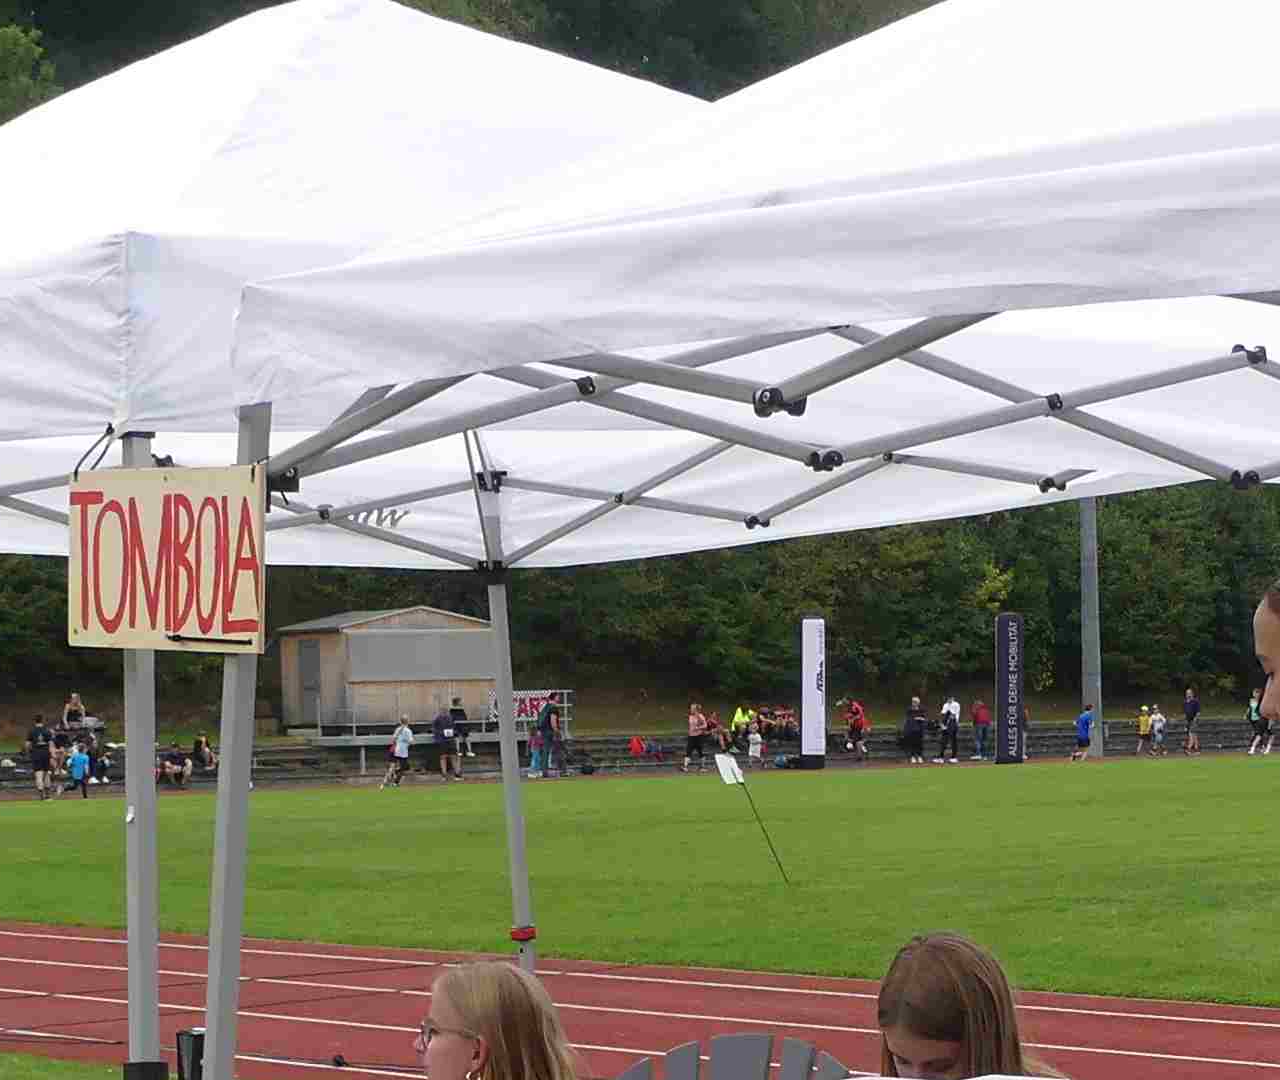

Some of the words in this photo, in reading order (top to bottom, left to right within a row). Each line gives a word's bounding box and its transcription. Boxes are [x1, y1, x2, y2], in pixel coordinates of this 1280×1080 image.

[70, 491, 260, 634] TOMBOLA
[1007, 620, 1018, 672] MOBILITÄT
[1008, 673, 1018, 704] DEINE
[1008, 728, 1018, 757] ALLES
